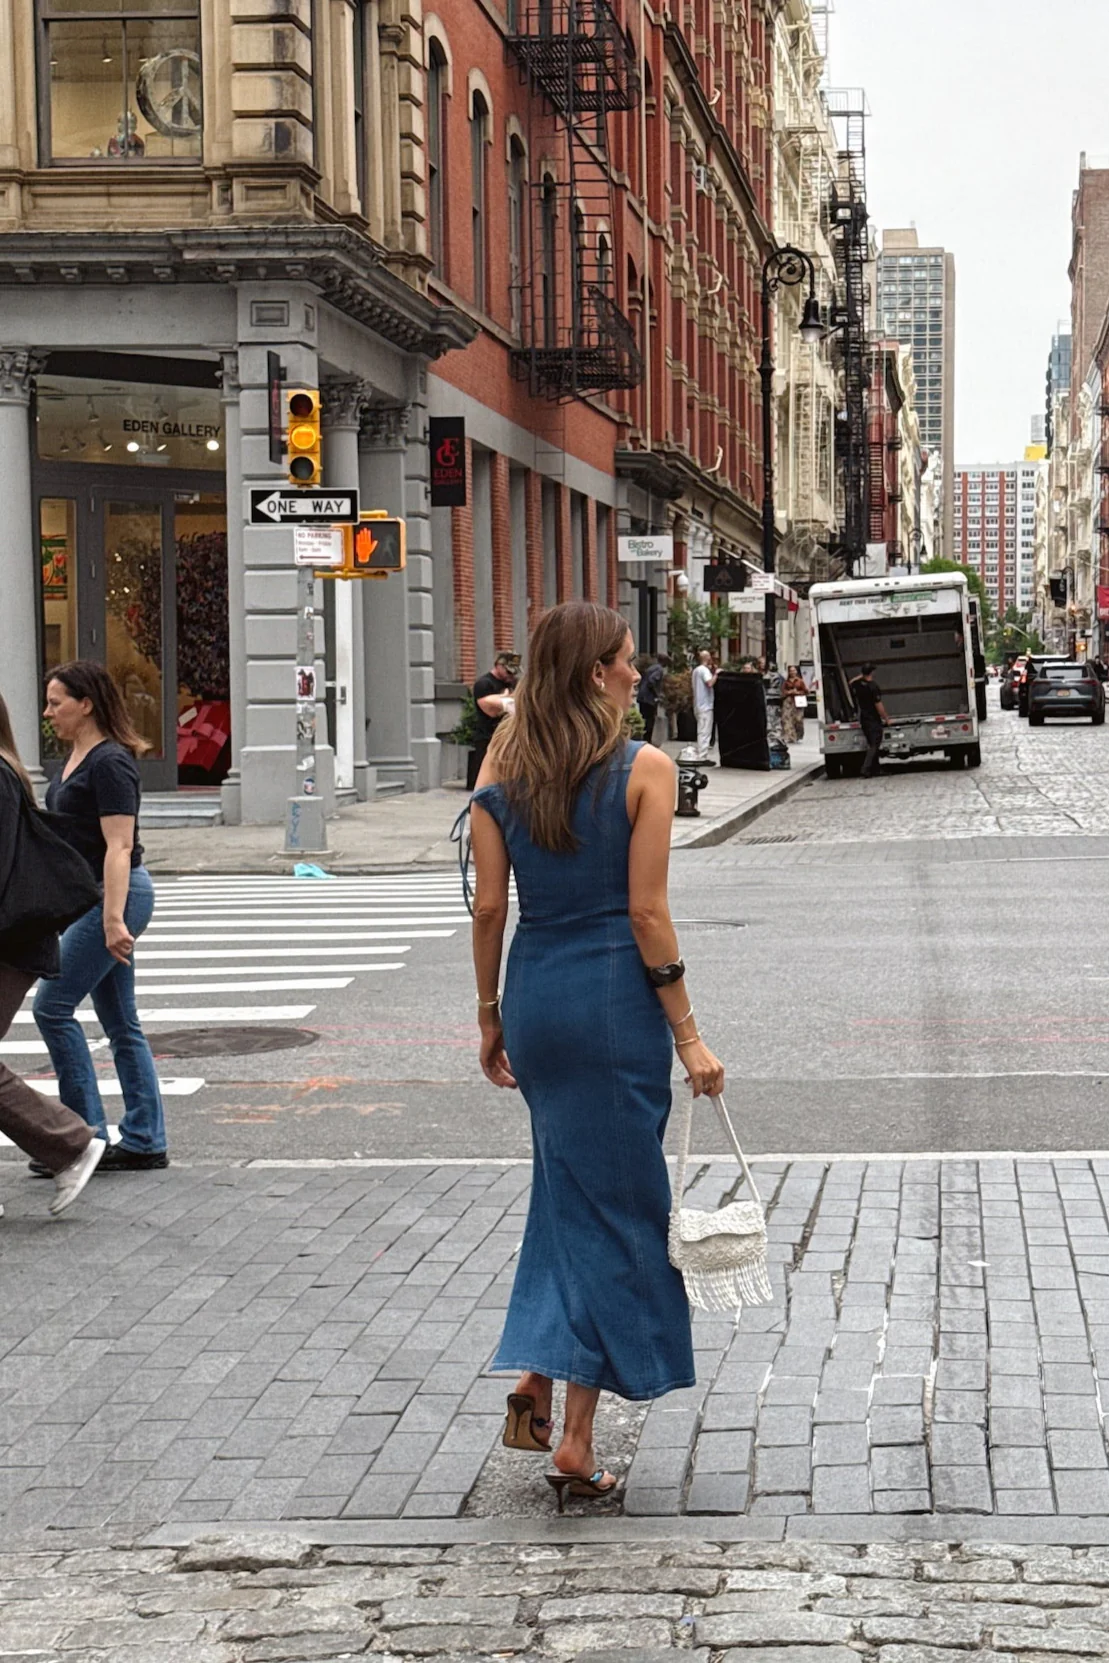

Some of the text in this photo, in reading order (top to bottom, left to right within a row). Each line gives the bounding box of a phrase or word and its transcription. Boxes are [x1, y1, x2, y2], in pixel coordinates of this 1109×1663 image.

[123, 419, 221, 438] EDEN GALLERY
[434, 468, 463, 478] EDEN
[267, 500, 345, 514] ONE WAY
[307, 532, 332, 540] PARKING
[627, 539, 654, 549] Bistro
[636, 548, 664, 558] Bakery
